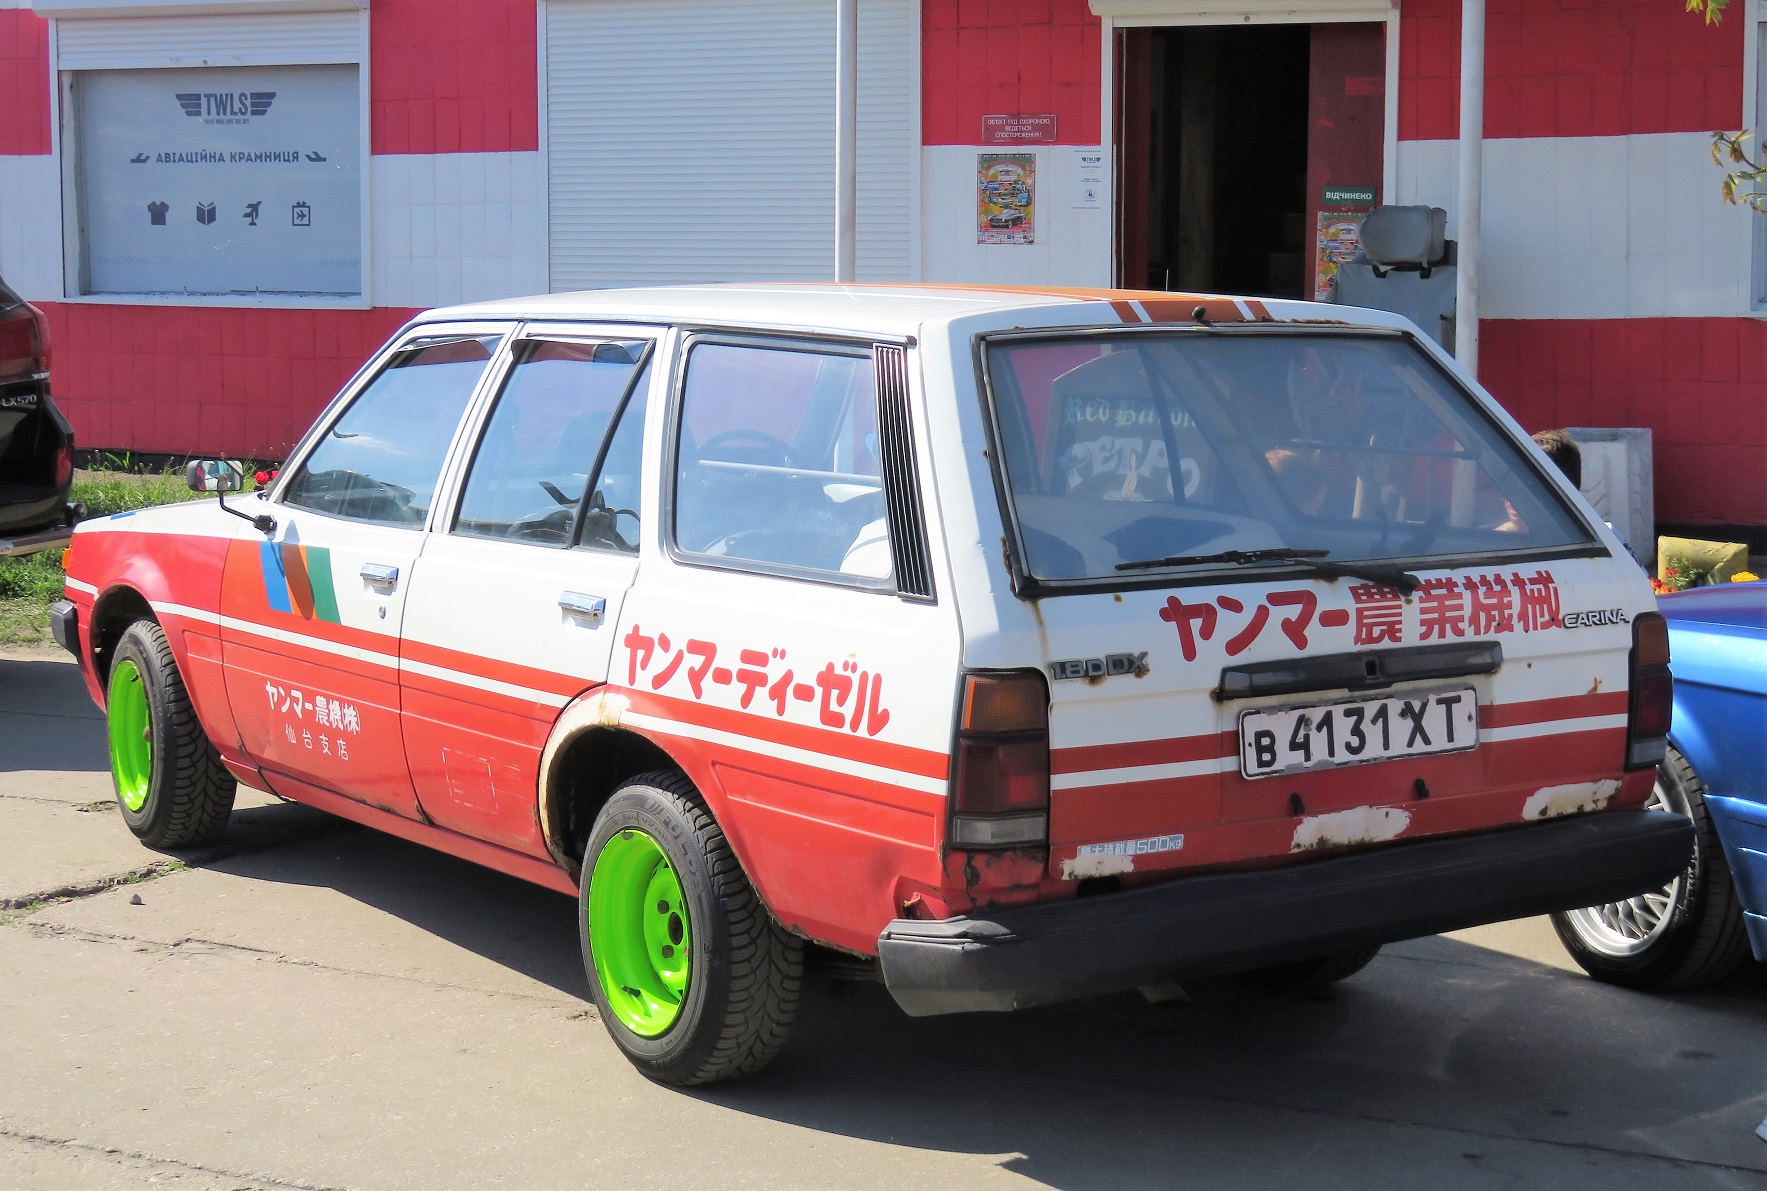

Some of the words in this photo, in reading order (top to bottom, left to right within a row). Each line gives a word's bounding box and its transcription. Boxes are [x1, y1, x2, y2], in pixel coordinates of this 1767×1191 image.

[203, 92, 249, 116] TWLS
[155, 149, 226, 164] АВІАЦІЙНА
[229, 151, 300, 164] КРАМНИЦЯ
[1325, 191, 1372, 200] ВІДЧИНЕНО
[1158, 569, 1564, 662] ヤンマー農業機械
[1562, 608, 1630, 630] CARINA
[623, 623, 890, 737] ヤンマーディーゼル
[285, 723, 349, 761] 仙台支店
